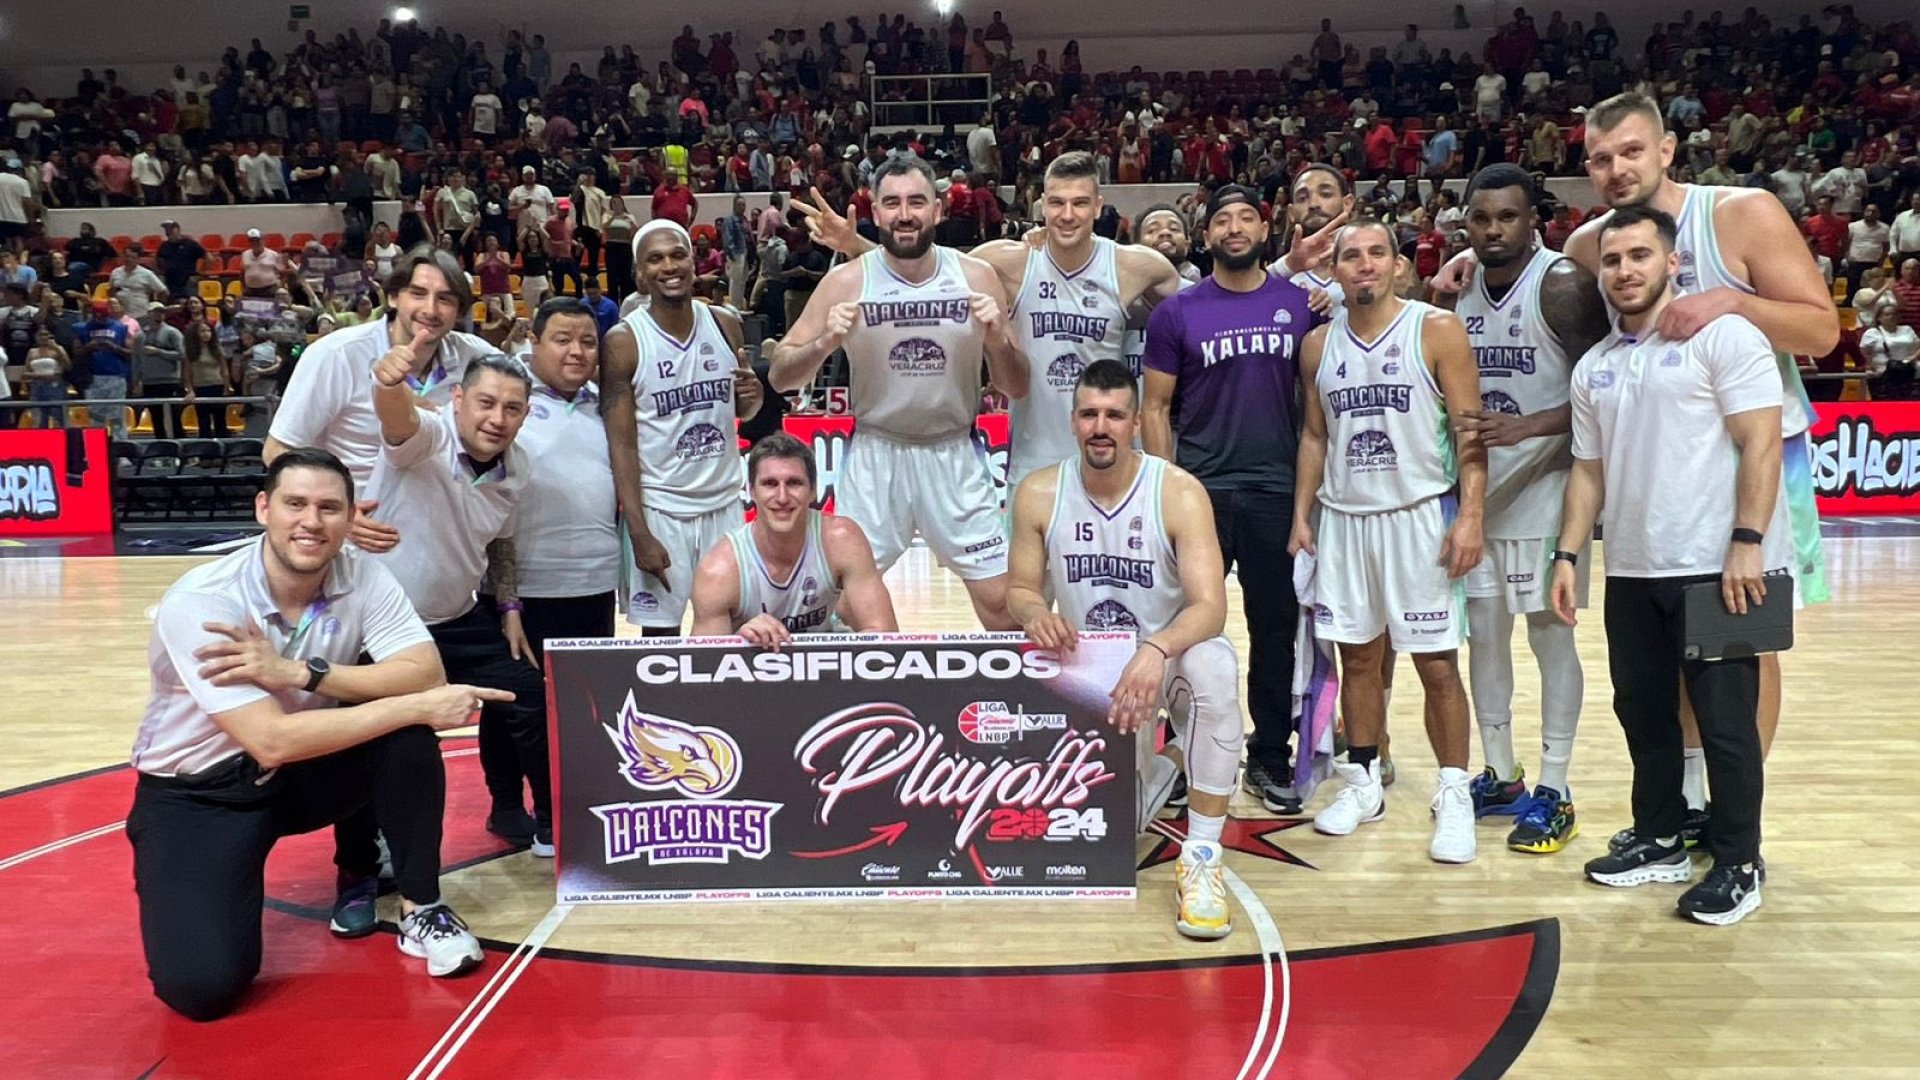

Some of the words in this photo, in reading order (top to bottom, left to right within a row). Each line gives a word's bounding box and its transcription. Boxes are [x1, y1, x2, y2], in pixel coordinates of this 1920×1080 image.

[1039, 281, 1057, 299] 32
[858, 298, 970, 327] HALCONES
[1466, 316, 1484, 334] 22
[657, 360, 676, 378] 12
[1336, 361, 1346, 378] 4
[1473, 346, 1537, 375] LCONES
[652, 378, 731, 417] HALCONES
[1075, 522, 1094, 541] 15
[1063, 553, 1155, 589] HALCONES
[1405, 611, 1449, 621] GYASA
[579, 639, 650, 647] CALIENTE.MX
[686, 637, 743, 645] PLAYOFFS
[791, 635, 847, 643] LIENTE.MX
[636, 649, 1062, 684] CLASIFICADOS
[979, 703, 1008, 712] LIGA
[979, 732, 1009, 741] LNBP
[797, 706, 1116, 850] Playoffs
[609, 806, 765, 854] HALCONES
[986, 807, 1108, 839] 2024
[1046, 864, 1087, 876] molten
